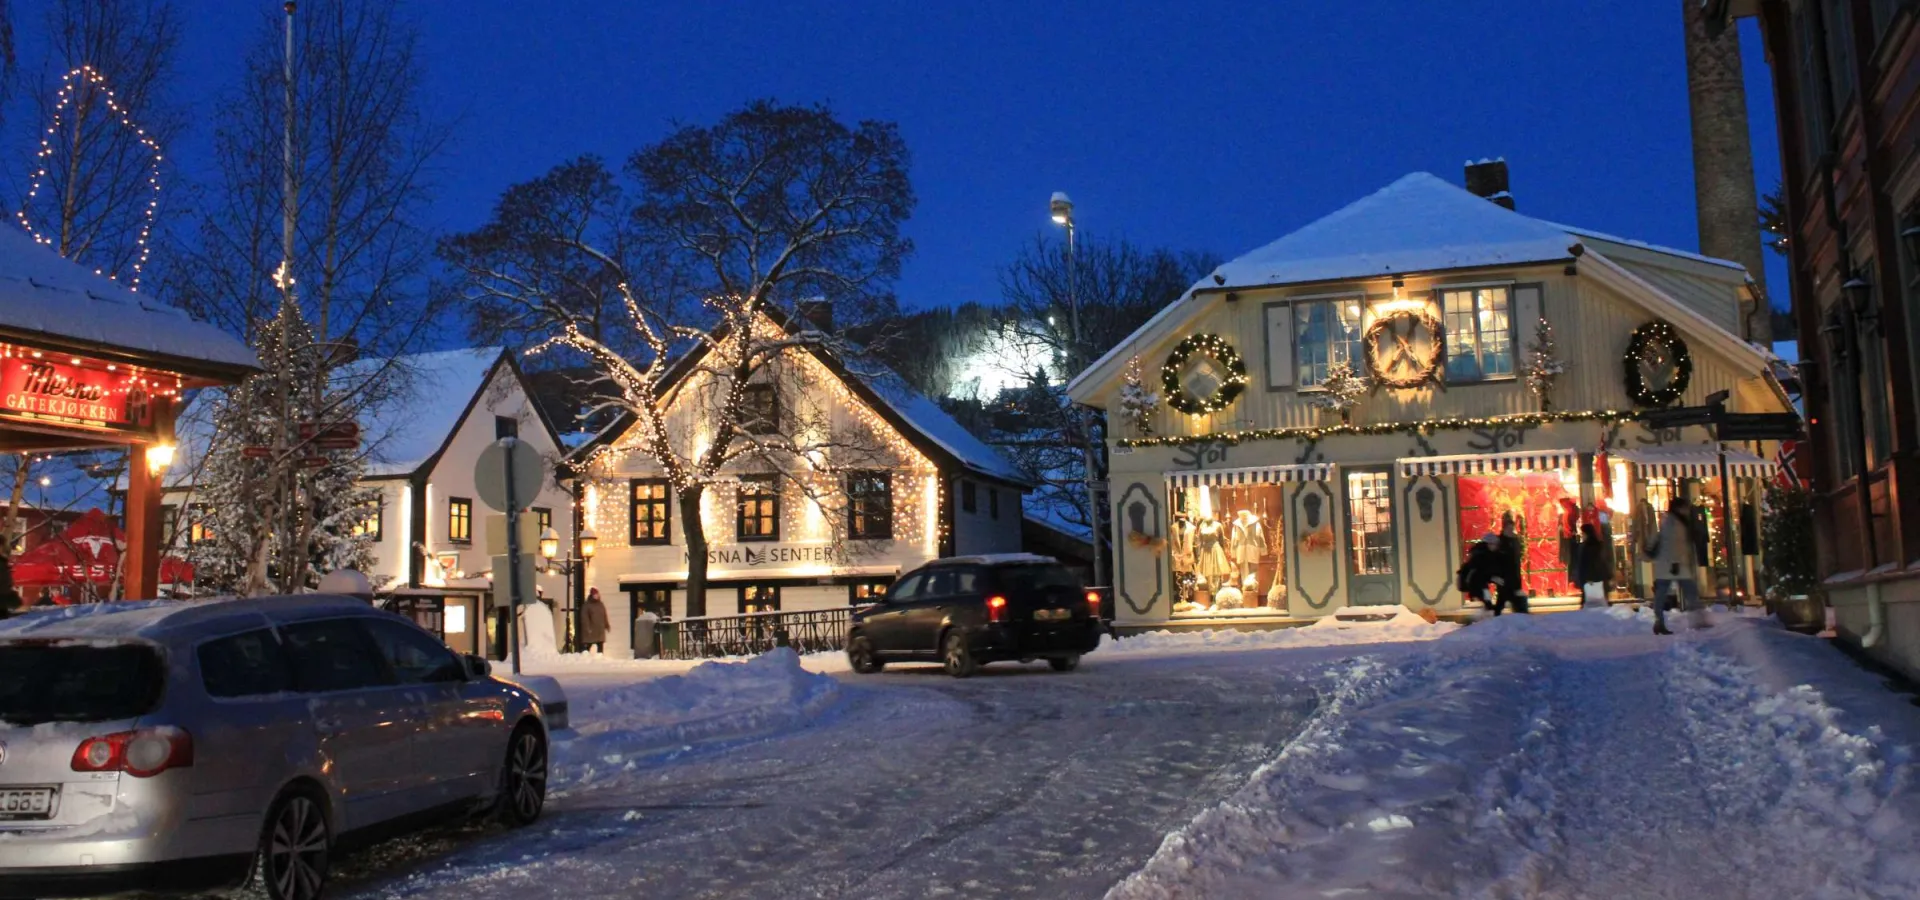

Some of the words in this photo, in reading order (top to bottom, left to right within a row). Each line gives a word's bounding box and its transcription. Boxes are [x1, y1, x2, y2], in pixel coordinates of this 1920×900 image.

[22, 362, 101, 401] Mesna
[6, 394, 117, 420] GATEKJØKKEN
[684, 550, 741, 564] SNA
[770, 547, 833, 561] SENTER
[57, 565, 116, 577] TESL
